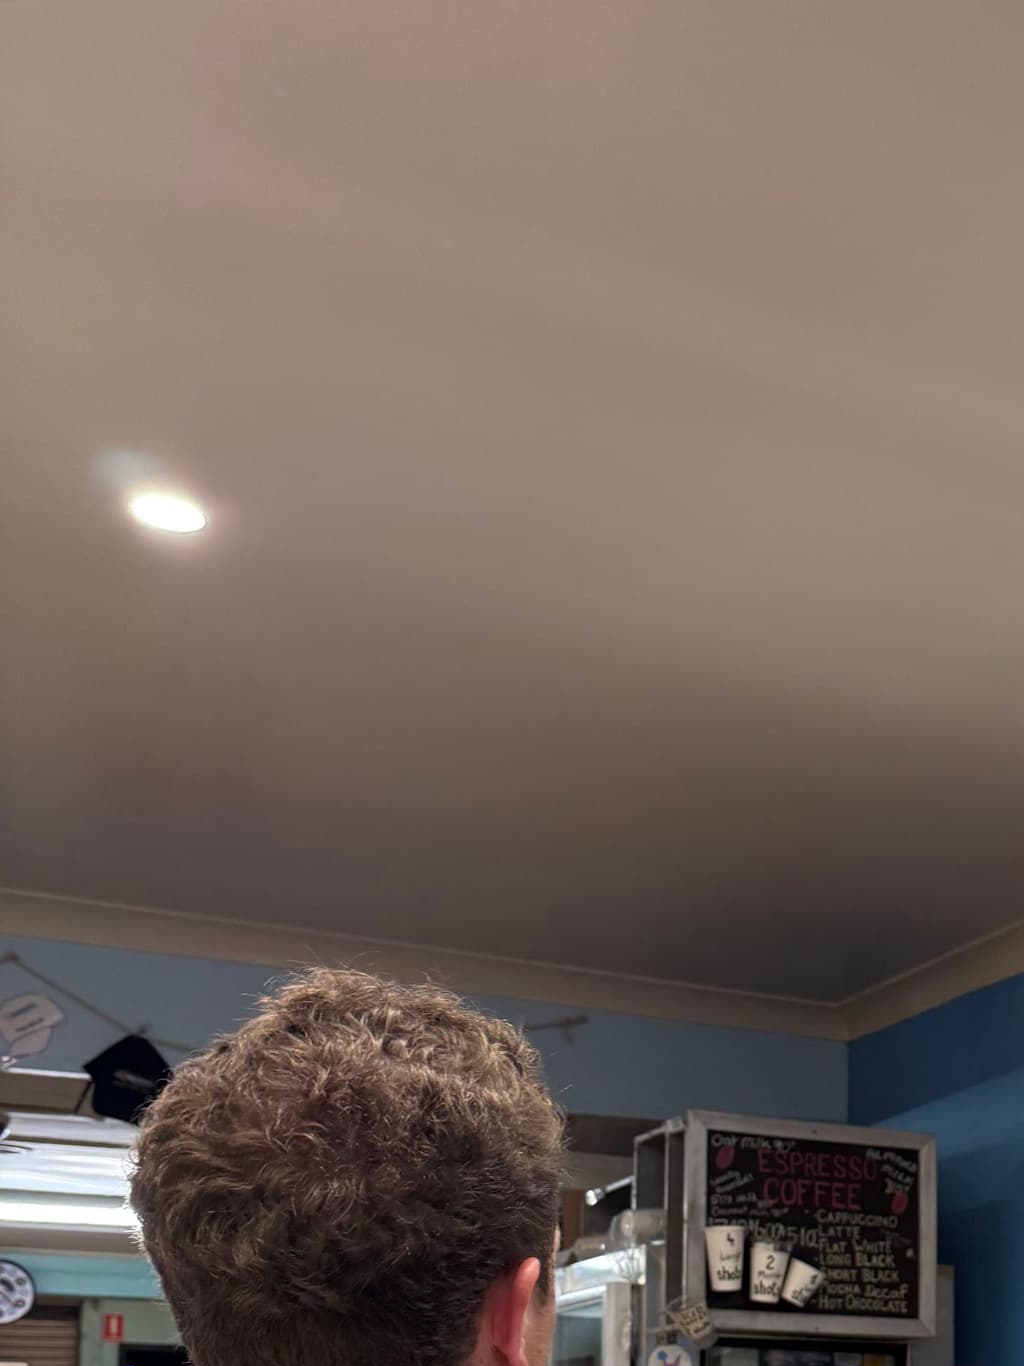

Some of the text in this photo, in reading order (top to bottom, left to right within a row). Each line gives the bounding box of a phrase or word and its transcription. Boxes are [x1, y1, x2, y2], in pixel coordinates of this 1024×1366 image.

[757, 1148, 877, 1183] ESPRESSO
[762, 1176, 862, 1212] COFFEE
[816, 1208, 899, 1229] CAPPUCCINO
[818, 1224, 861, 1239] LATTE
[818, 1237, 893, 1254] FLAT WHITE
[766, 1254, 775, 1270] 2
[818, 1252, 897, 1268] LONG BLACK
[861, 1268, 901, 1283] BLACK
[816, 1296, 909, 1313] HOT CHOCOLATE
